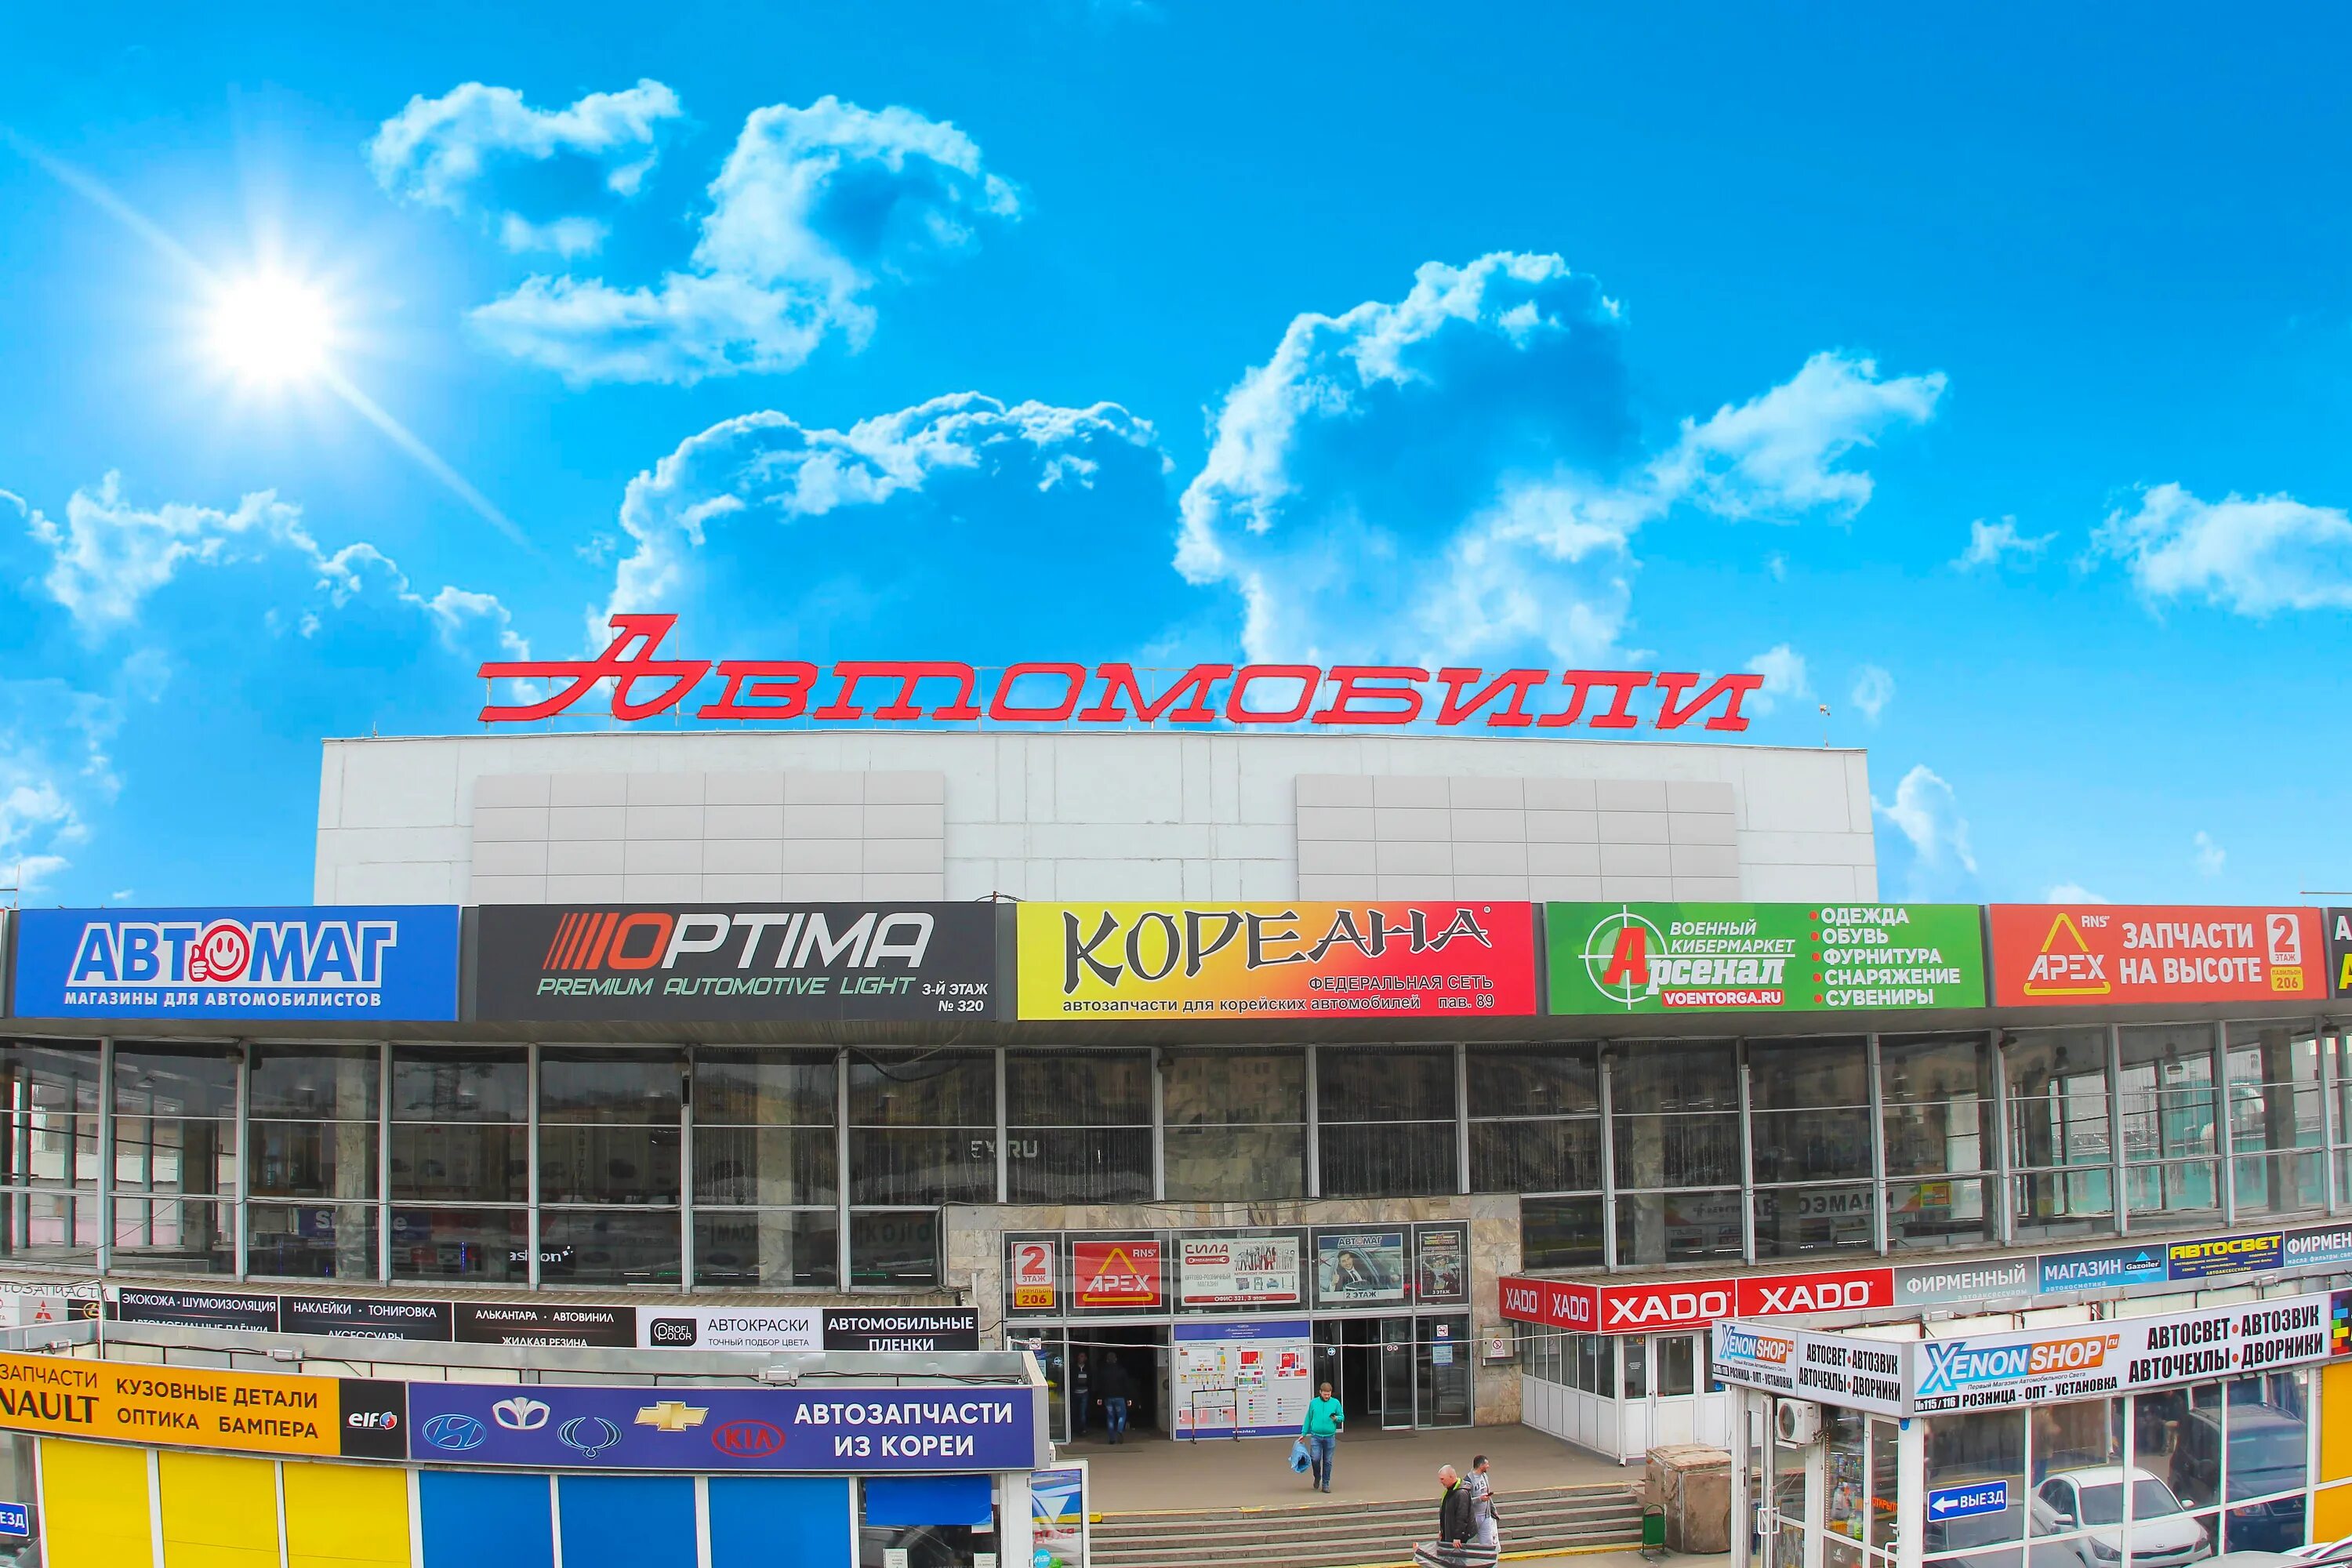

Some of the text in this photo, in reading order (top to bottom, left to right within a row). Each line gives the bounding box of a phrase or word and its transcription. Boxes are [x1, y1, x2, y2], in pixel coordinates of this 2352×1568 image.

[1822, 908, 1910, 926] ОДЕЖДА
[1670, 918, 1756, 937] ВОЕННЫЙ
[1822, 928, 1889, 945] ОБУВЬ
[2122, 921, 2253, 949] ЗАПЧАСТИ
[2273, 917, 2293, 953] 2
[608, 912, 935, 970] OPTIMA
[1671, 939, 1795, 954] КИБЕРМАРКЕТ
[1062, 908, 1492, 993] КОРЕАНА
[1823, 948, 1942, 966] ФУРНИТУРА
[1602, 927, 1784, 996] Арсенал
[2027, 954, 2106, 981] APEX
[2119, 956, 2262, 984] НА ВЫСОТЕ
[1308, 975, 1493, 993] ФЕДЕРАЛЬНАЯ СЕТЬ
[1824, 968, 1960, 985] СНАРЯЖЕНИЕ
[2276, 976, 2299, 989] 206
[537, 976, 916, 996] PREMIUM AUTOMOTIVE LIGHT
[921, 979, 989, 996] 3-Й ЭТАЖ
[64, 992, 382, 1007] МАГАЗИНЫ ДЛЯ АВТОМОБИЛИСТОВ
[958, 1000, 984, 1012] 320
[1062, 994, 1494, 1012] автозапчасти для корейских автомобилей пав. 89
[1664, 991, 1782, 1004] VOENTORGA.RU
[1826, 989, 1934, 1007] СУВЕНИРЫ
[1185, 1244, 1229, 1254] СИЛА
[2169, 1236, 2281, 1259] АВТОСВЕТ
[1022, 1246, 1046, 1275] 2
[2045, 1259, 2122, 1280] МАГАЗИН
[2126, 1261, 2158, 1270] Gazoiler
[1907, 1264, 2025, 1294] ФИРМЕННЫЙ
[2206, 1266, 2251, 1276] АВТОАКСЕССУАРЫ
[1086, 1275, 1150, 1292] APEX
[2045, 1281, 2107, 1292] автокосметика
[122, 1294, 276, 1312] ЭКОКОЖА ШУМОИЗОЛЯЦИЯ
[1022, 1295, 1047, 1304] 206
[1505, 1287, 1537, 1313] XADO
[1759, 1280, 1870, 1314] XADO
[293, 1301, 437, 1318] НАКЛЕЙКИ ТОНИРОВКА
[475, 1309, 614, 1323] АЛЬКАНТАРА АВТОВИНИЛ
[1552, 1293, 1590, 1322] XADO
[1608, 1290, 1727, 1325] XADO
[708, 1319, 808, 1331] АВТОКРАСКИ
[828, 1316, 974, 1330] АВТОМОБИЛЬНЫЕ
[2147, 1305, 2319, 1350] АВТОСВЕТ АВТОЗВУК
[502, 1336, 588, 1348] ЖИДКАЯ РЕЗИНА
[709, 1338, 743, 1346] ТОЧНЫЙ
[868, 1338, 934, 1351] ПЛЕНКИ
[1719, 1324, 1785, 1360] XENON SHOP
[1806, 1343, 1898, 1375] АВТОСВЕТ АВТОЗВУК
[2129, 1333, 2323, 1383] АВТОЧЕХЛЫ ДВОРНИКИ
[1916, 1341, 2027, 1395] XENON
[2031, 1341, 2101, 1370] SHOP
[1753, 1371, 1762, 1383] ОПТ
[1765, 1374, 1793, 1389] УСТАНОВКА
[1798, 1367, 1900, 1403] АВТОЧЕХЛЫ ДВОРНИКИ
[1992, 1380, 2018, 1389] Магазин
[2019, 1375, 2067, 1385] Автомобильного
[116, 1377, 318, 1408] КУЗОВНЫЕ ДЕТАЛИ
[1962, 1388, 2016, 1407] РОЗНИЦА
[2025, 1385, 2047, 1400] ОПТ
[2056, 1377, 2118, 1396] УСТАНОВКА
[118, 1407, 318, 1439] ОПТИКА БАМПЕРА
[348, 1412, 379, 1426] elf
[794, 1403, 1012, 1425] АВТОЗАПЧАСТИ
[726, 1428, 770, 1450] KIA
[834, 1436, 974, 1457] ИЗ КОРЕИ
[1960, 1489, 2004, 1509] ВЫЕЗД
